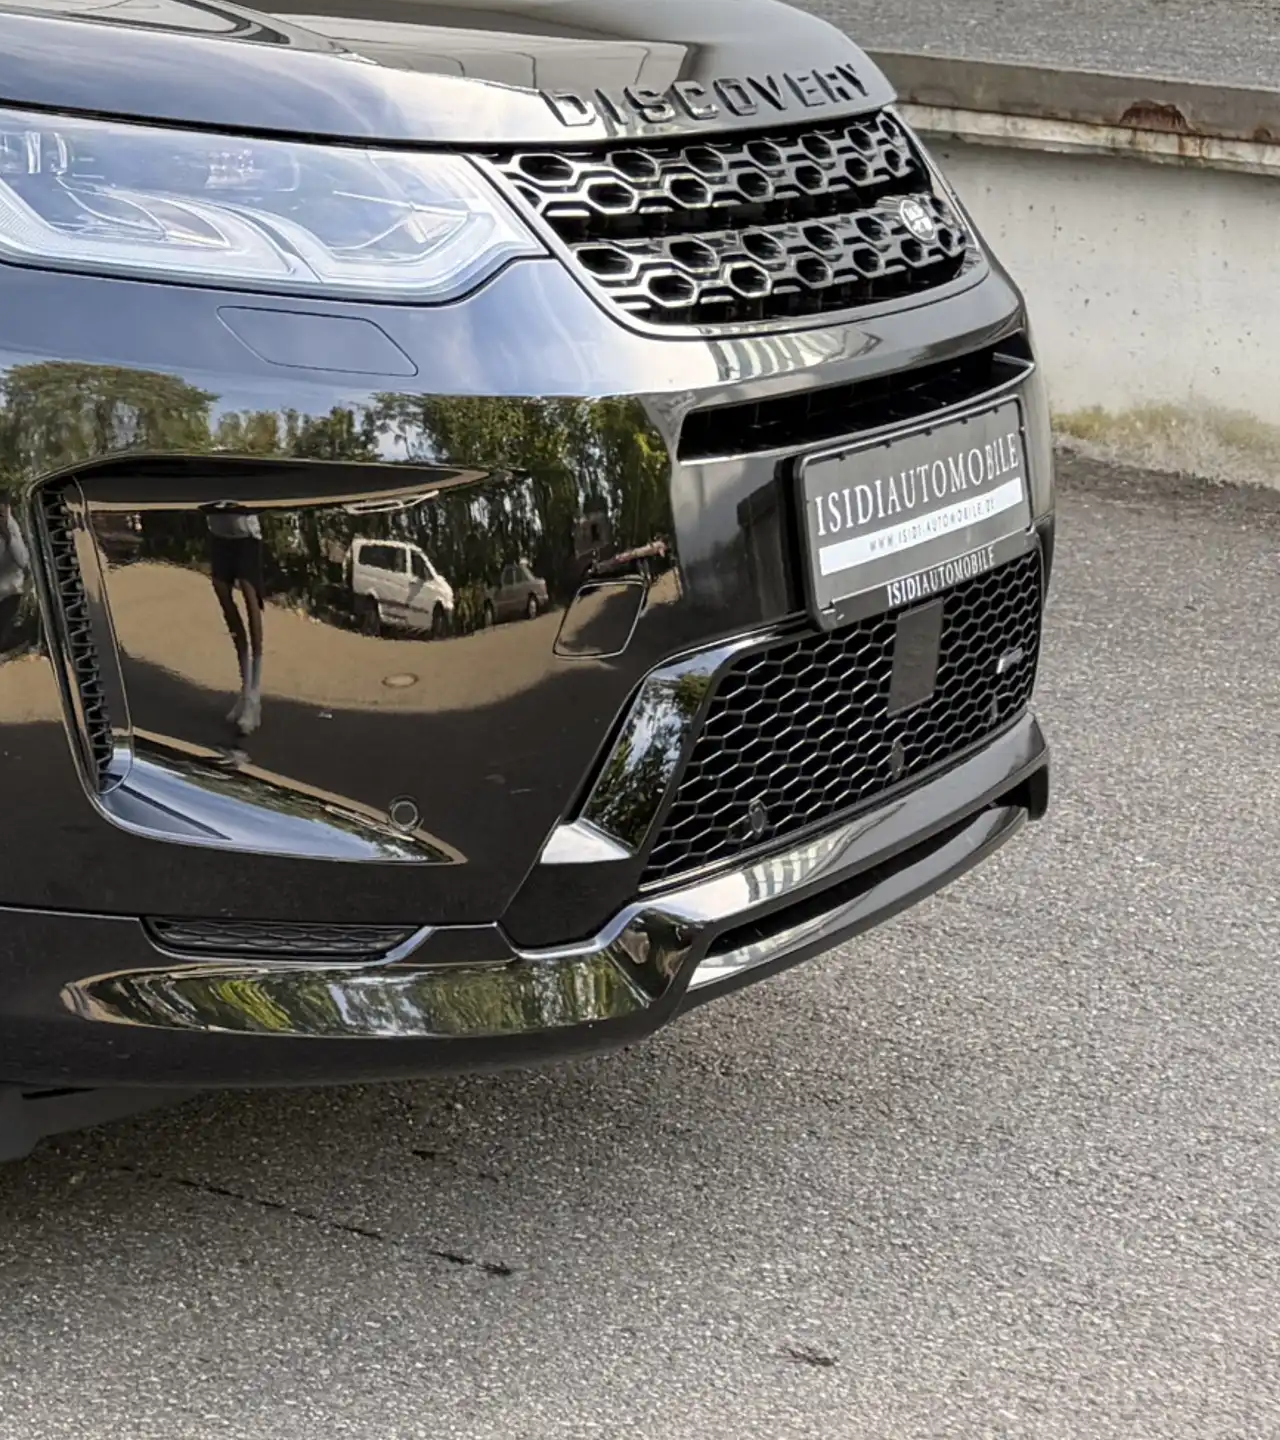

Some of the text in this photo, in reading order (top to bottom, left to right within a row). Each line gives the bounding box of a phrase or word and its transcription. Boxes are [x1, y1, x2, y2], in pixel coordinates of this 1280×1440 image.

[541, 62, 870, 128] DISCOVERY
[815, 432, 1020, 537] ISIDIAUTOMOBILE
[886, 545, 996, 608] ISIDIAUTOMOBILE
